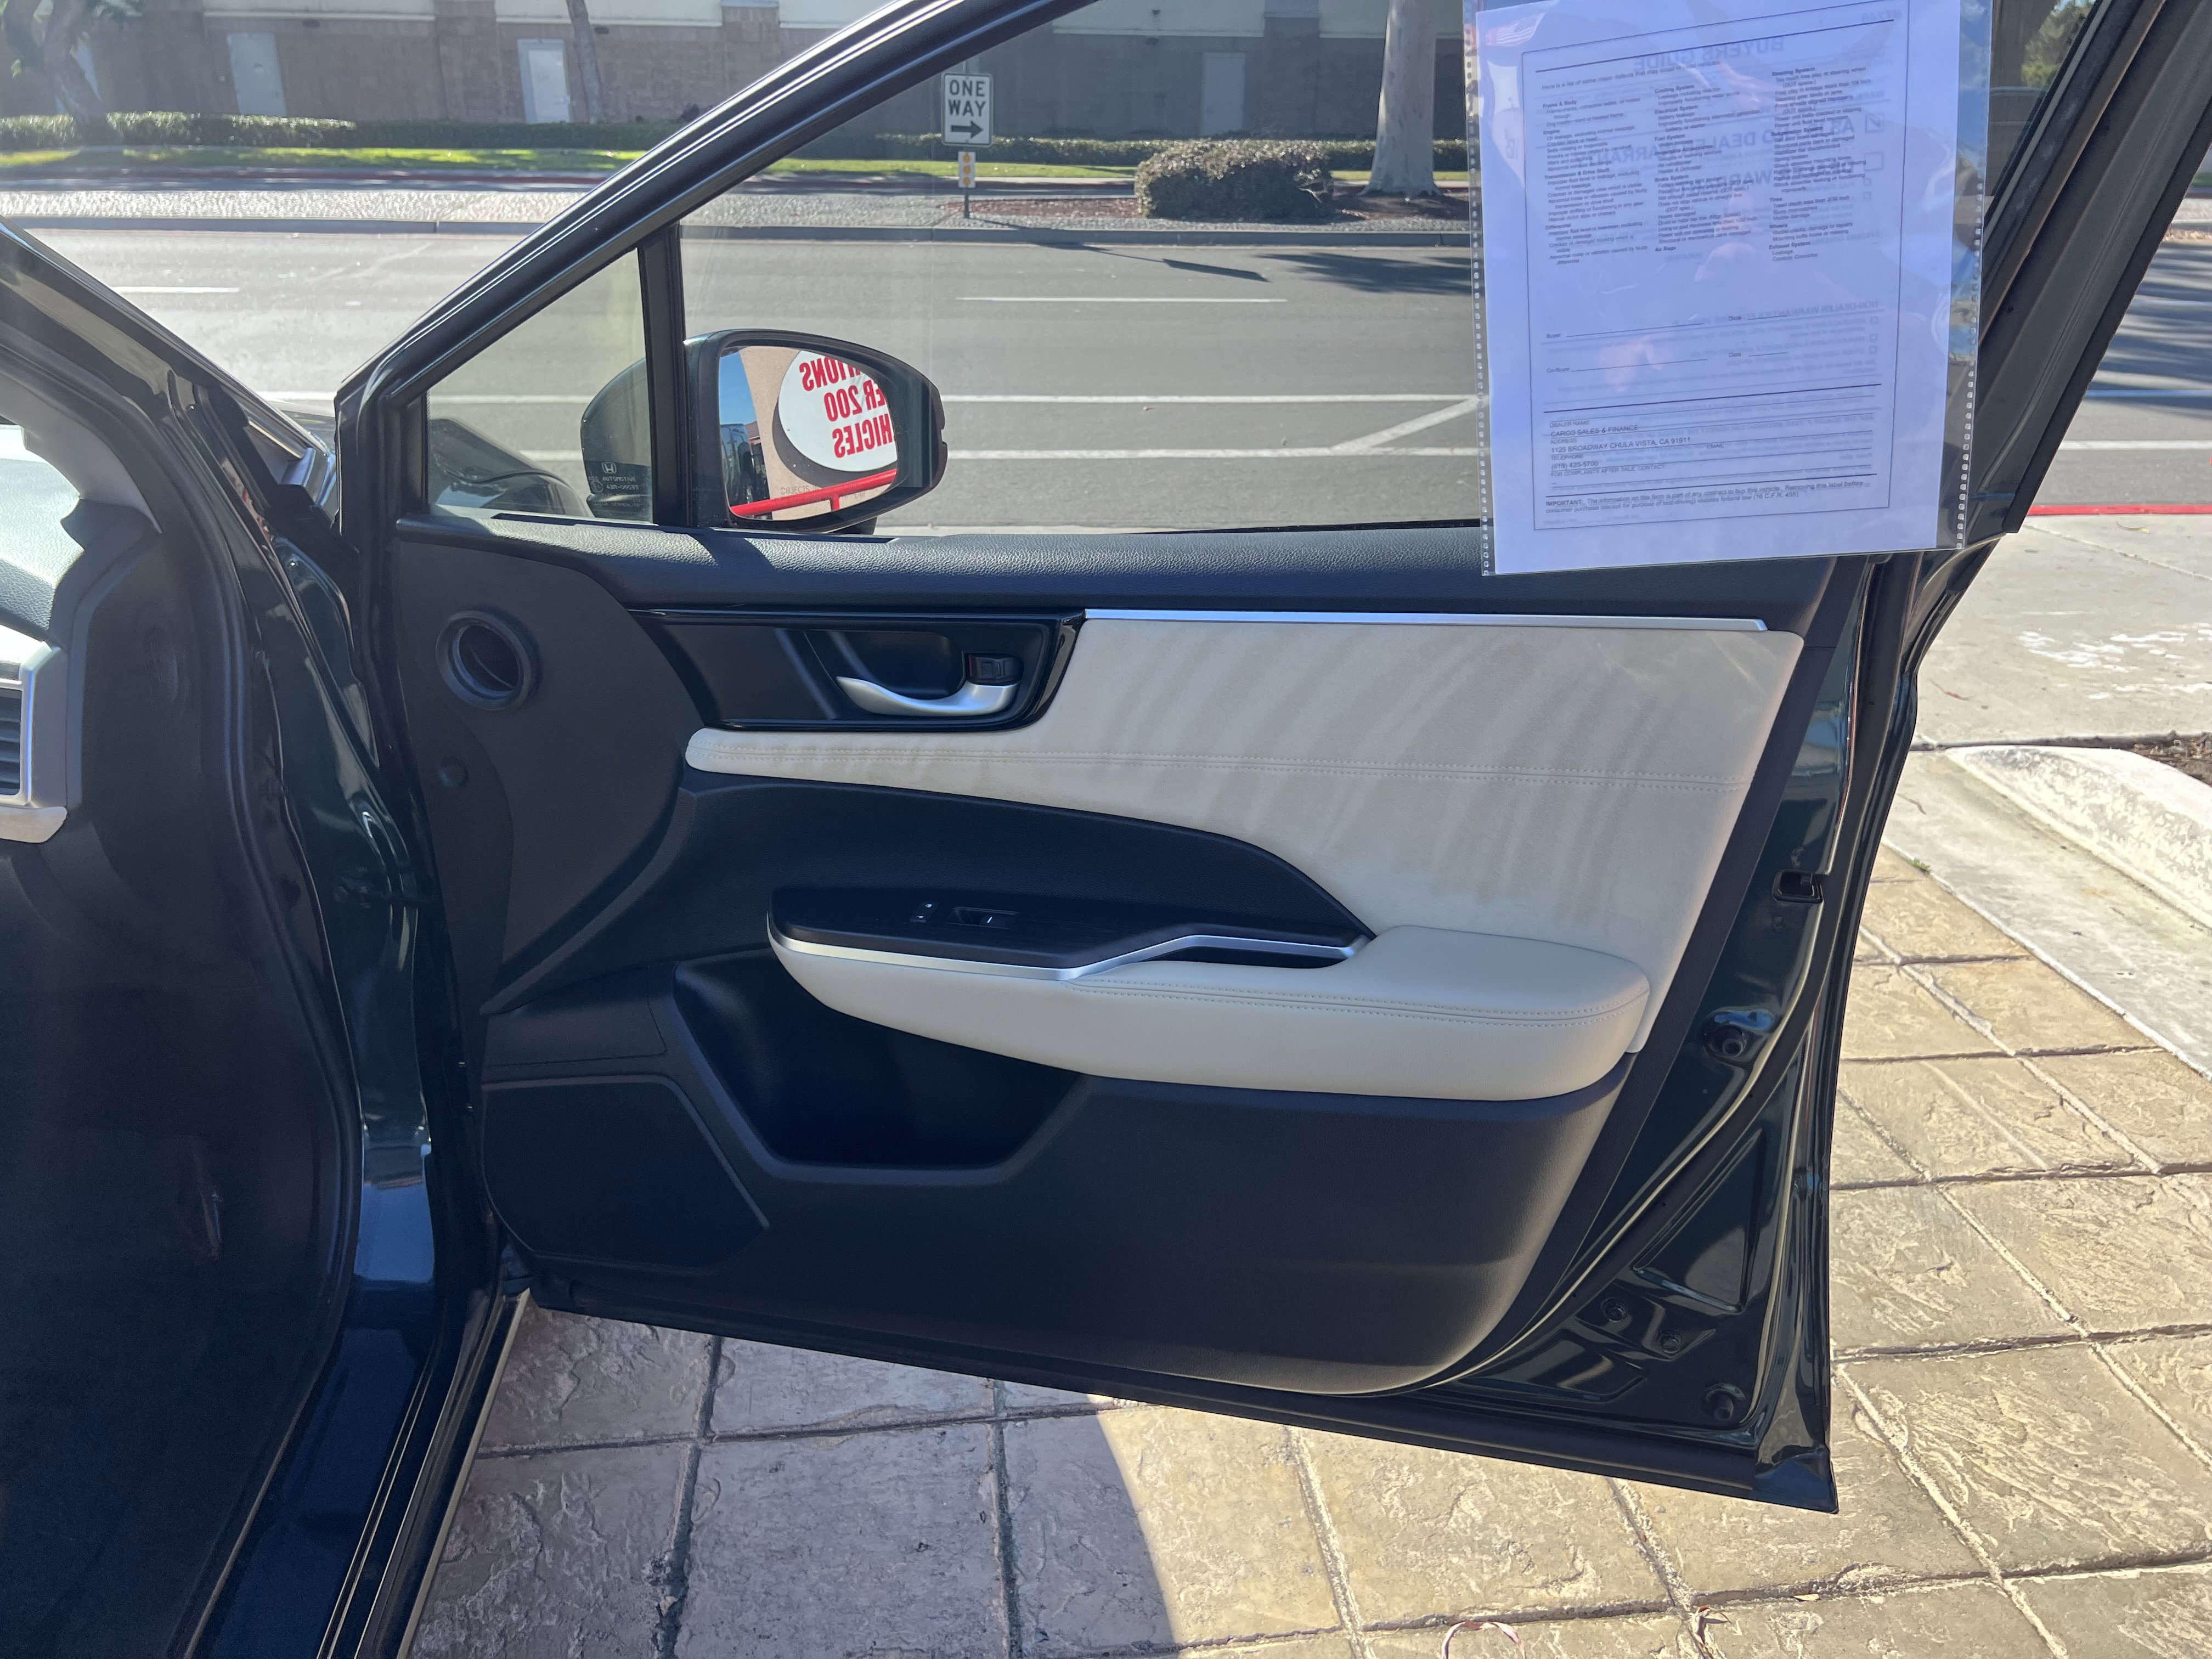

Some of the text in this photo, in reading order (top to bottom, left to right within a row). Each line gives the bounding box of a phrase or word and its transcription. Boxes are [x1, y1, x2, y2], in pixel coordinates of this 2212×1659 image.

[949, 79, 985, 97] ONE
[948, 99, 986, 117] WAY
[1567, 443, 1609, 452] BROADWAY
[1551, 462, 1568, 470] (619)
